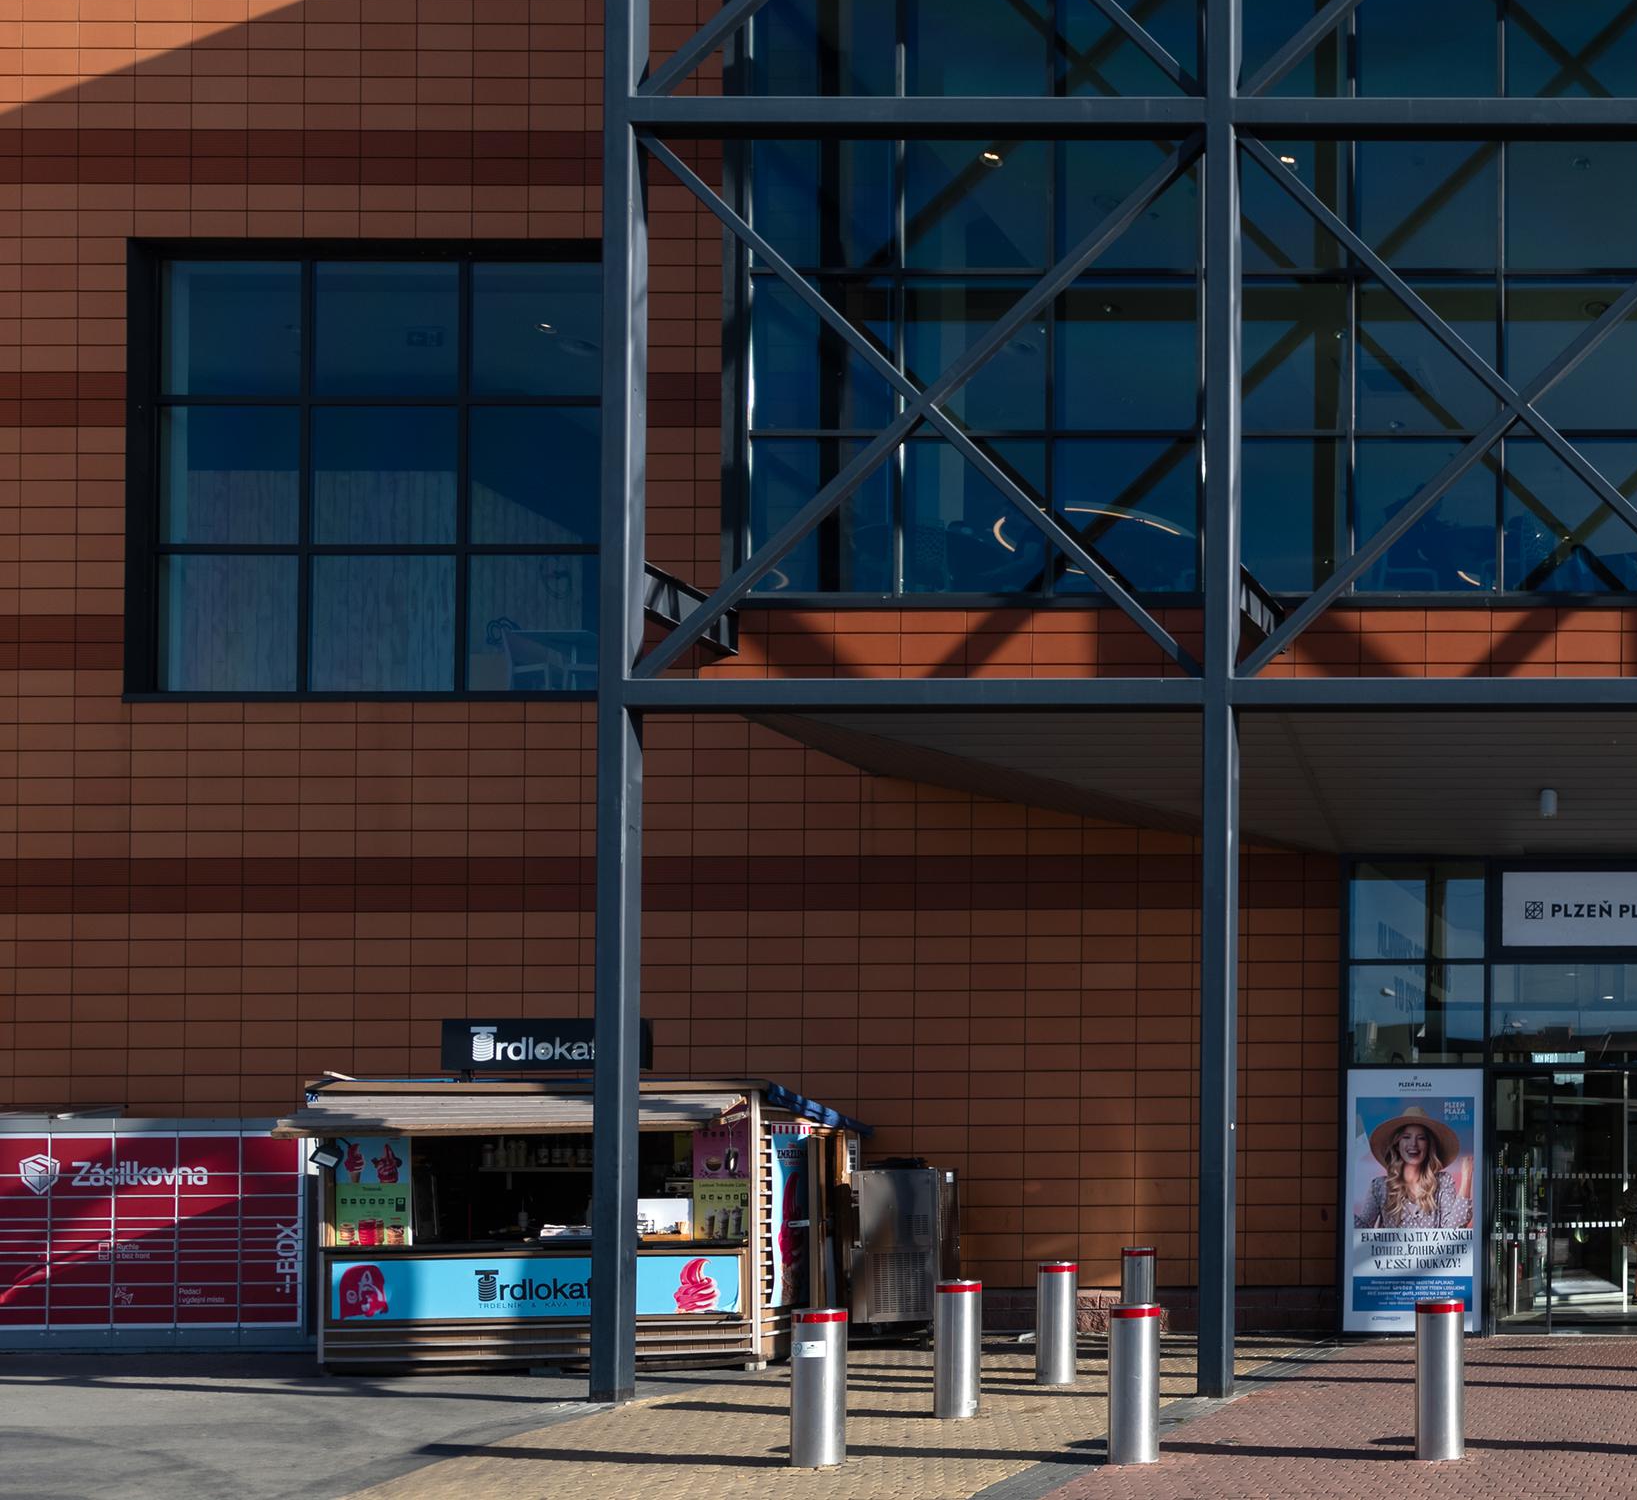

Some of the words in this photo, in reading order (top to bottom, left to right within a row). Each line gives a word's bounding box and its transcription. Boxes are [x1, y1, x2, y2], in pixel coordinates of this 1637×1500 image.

[1551, 900, 1612, 918] PLZEŇ
[71, 1161, 208, 1187] Zásilkovna
[1440, 1229, 1473, 1242] VAŠICH
[116, 1243, 140, 1252] Rychle
[1409, 1242, 1468, 1257] HRÁVEJTE
